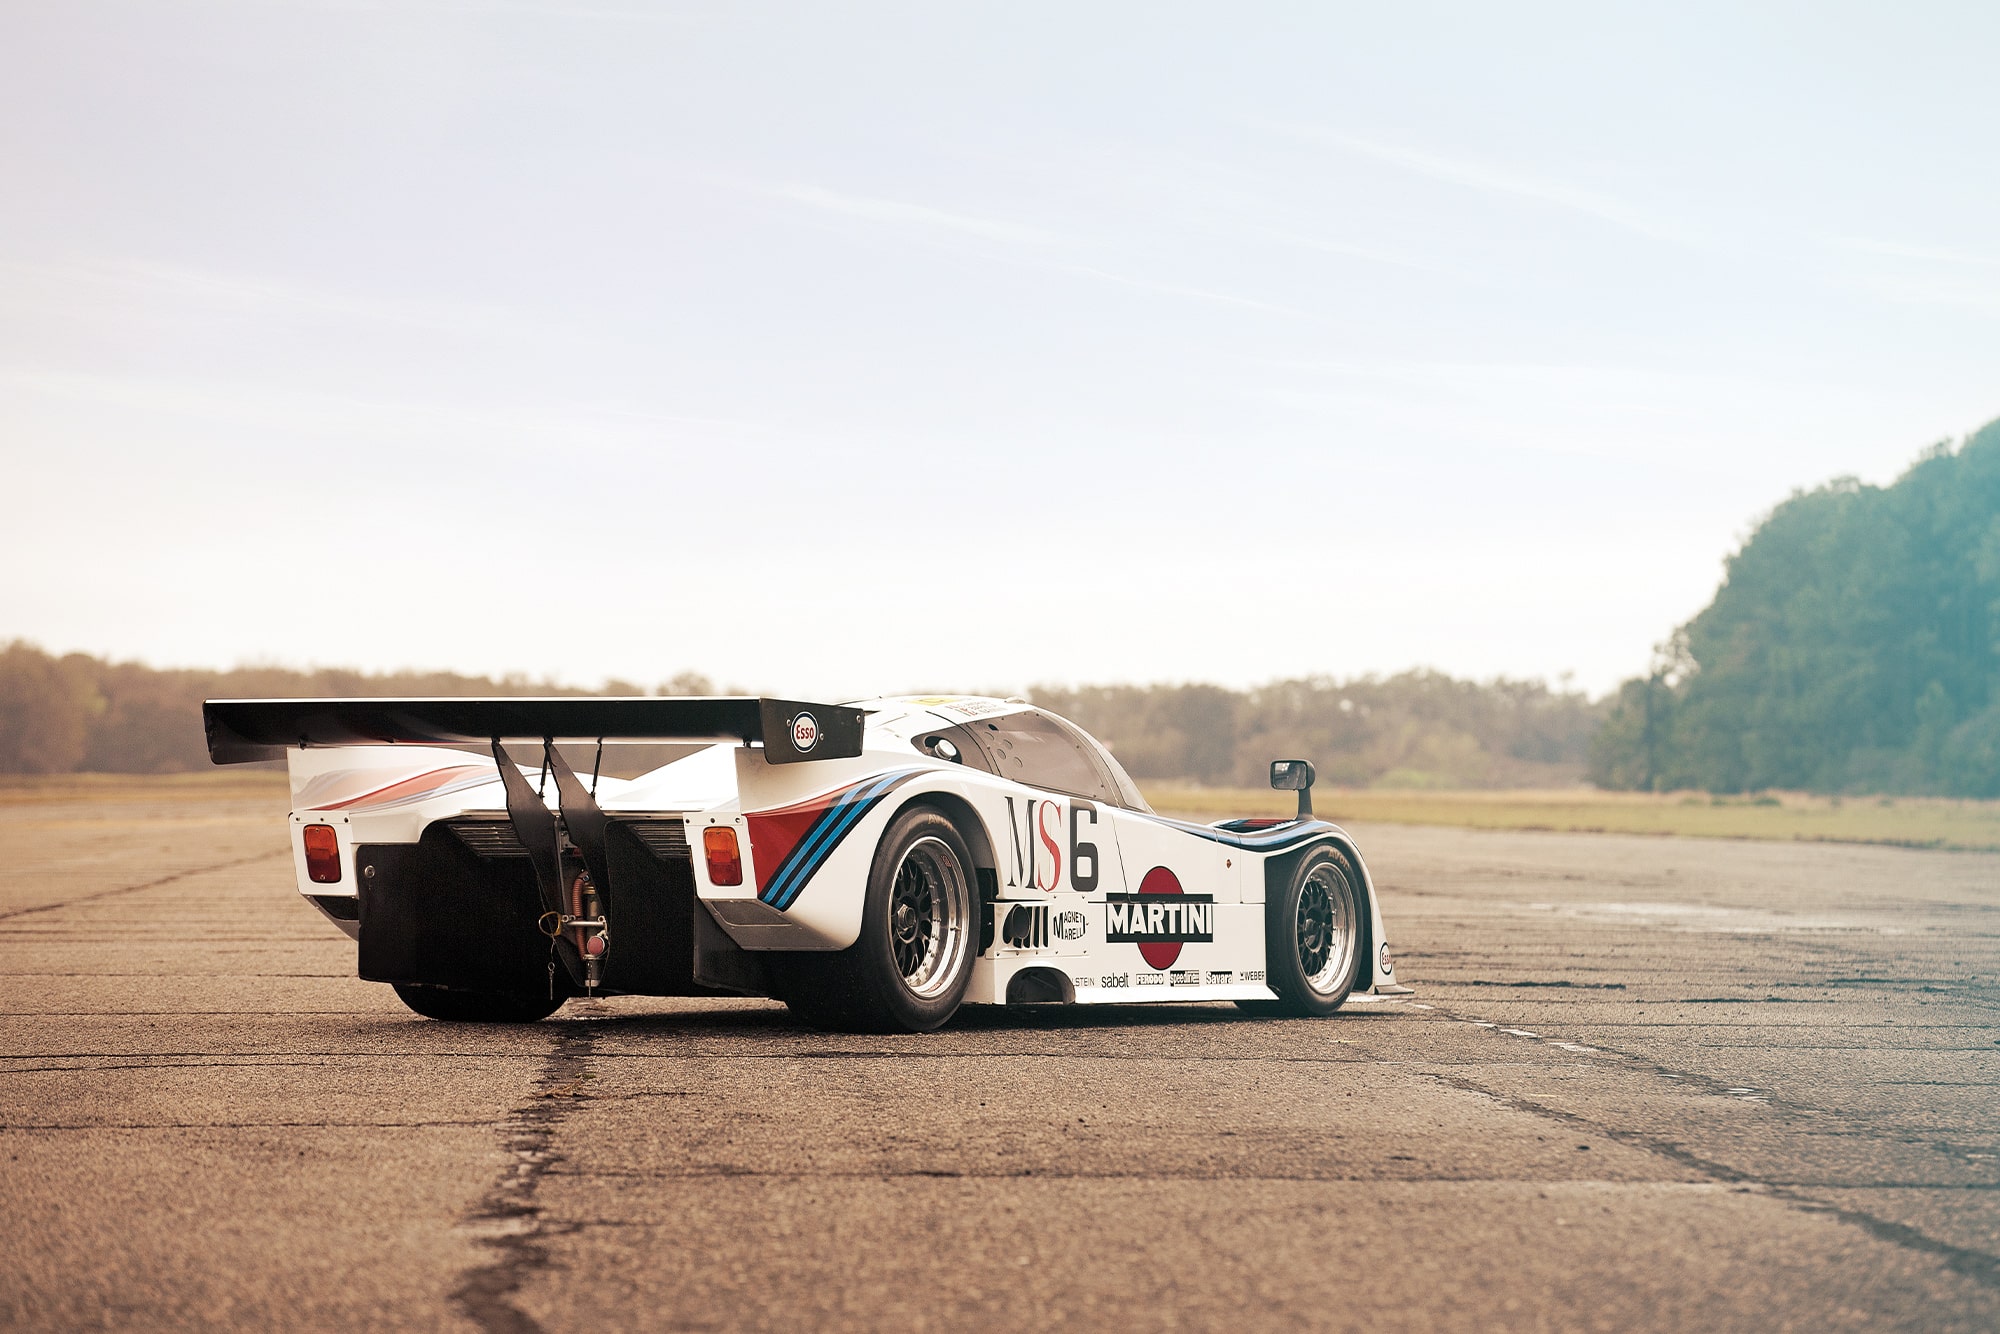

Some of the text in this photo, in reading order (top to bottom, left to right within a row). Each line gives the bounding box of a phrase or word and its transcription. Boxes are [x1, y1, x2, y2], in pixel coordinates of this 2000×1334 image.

[795, 724, 815, 740] Esso
[1107, 903, 1213, 935] MARTINI
[1101, 972, 1129, 988] sabelt
[1136, 974, 1164, 985] FERODO
